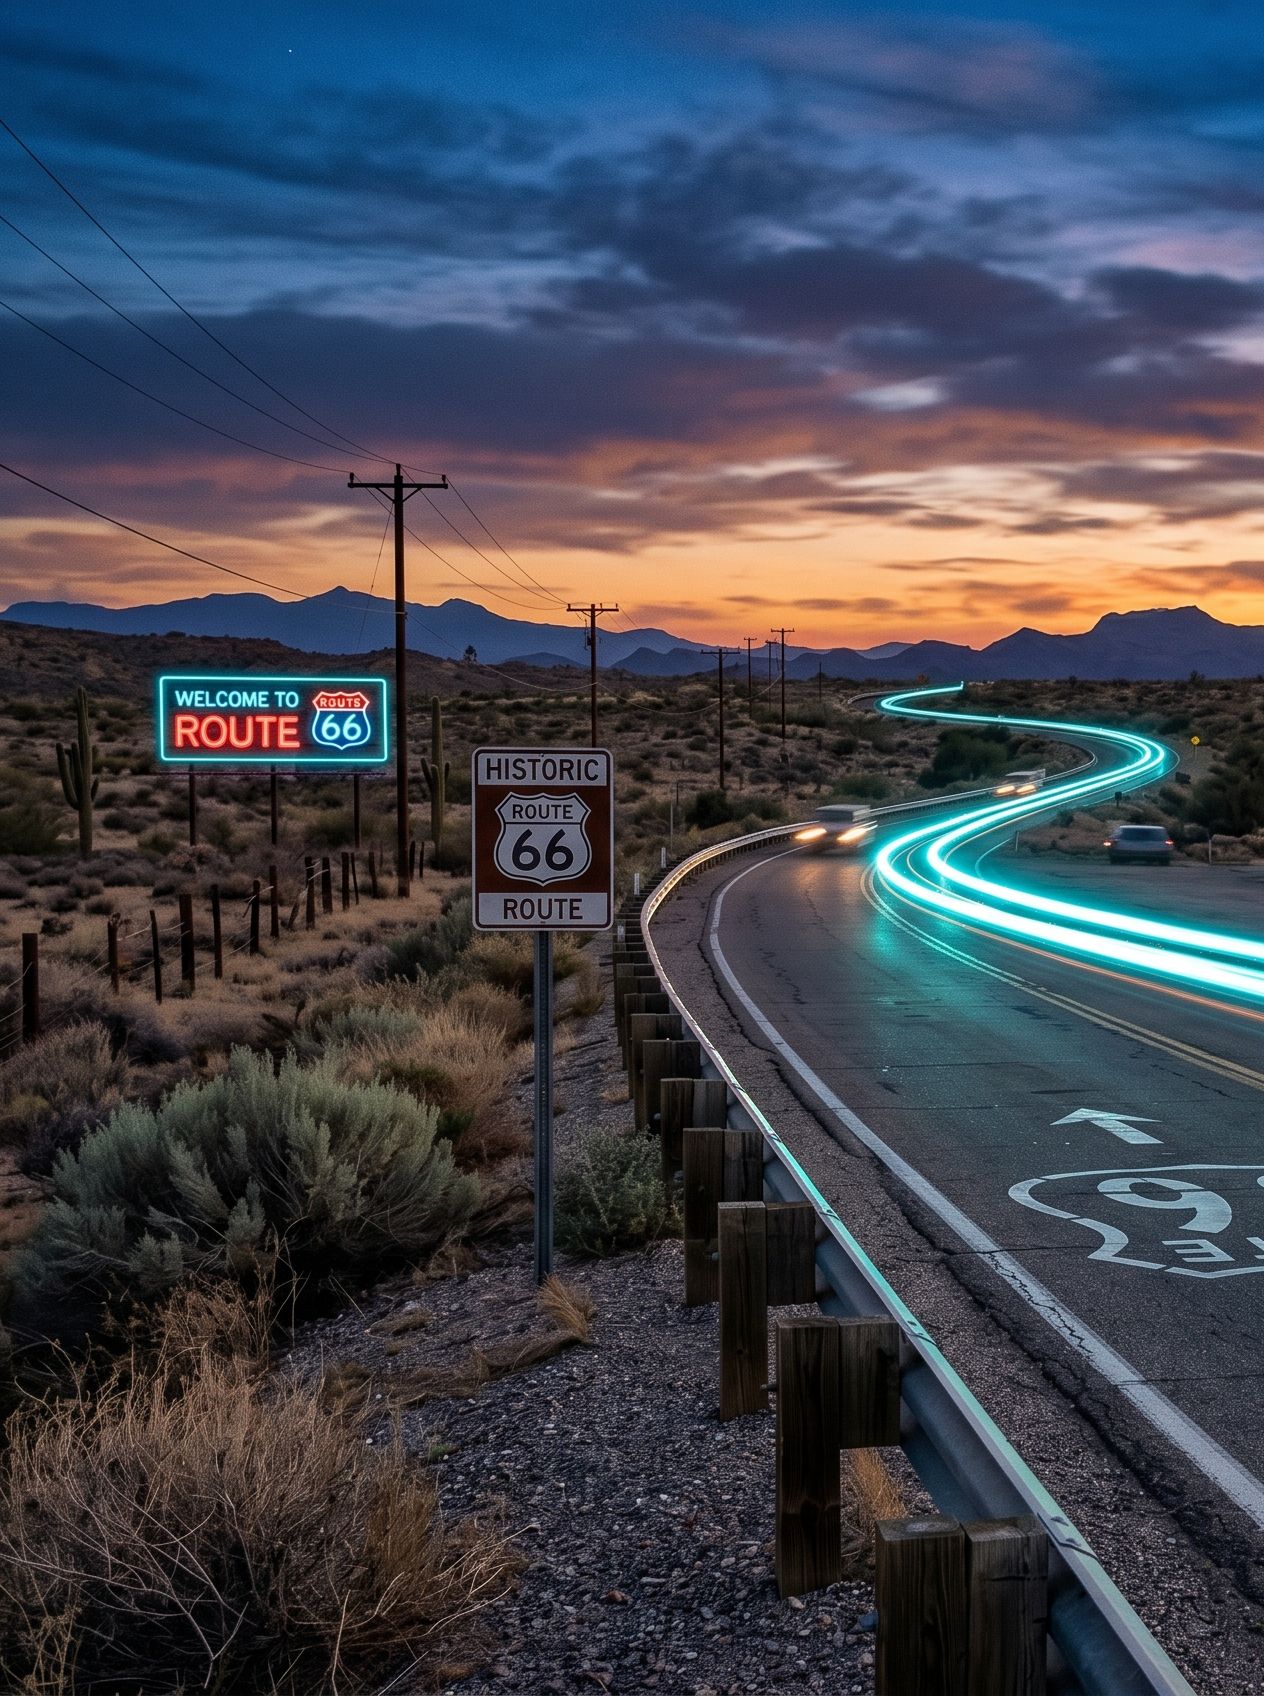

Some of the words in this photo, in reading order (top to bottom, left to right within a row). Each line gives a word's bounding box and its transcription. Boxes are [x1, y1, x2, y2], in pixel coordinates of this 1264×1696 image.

[175, 690, 269, 707] WELCOME
[275, 691, 299, 707] TO
[175, 714, 300, 748] ROUTE
[321, 714, 361, 740] 66
[486, 758, 599, 781] HISTORIC
[512, 804, 573, 820] ROUTE
[512, 828, 574, 871] 66
[503, 898, 583, 920] ROUTE
